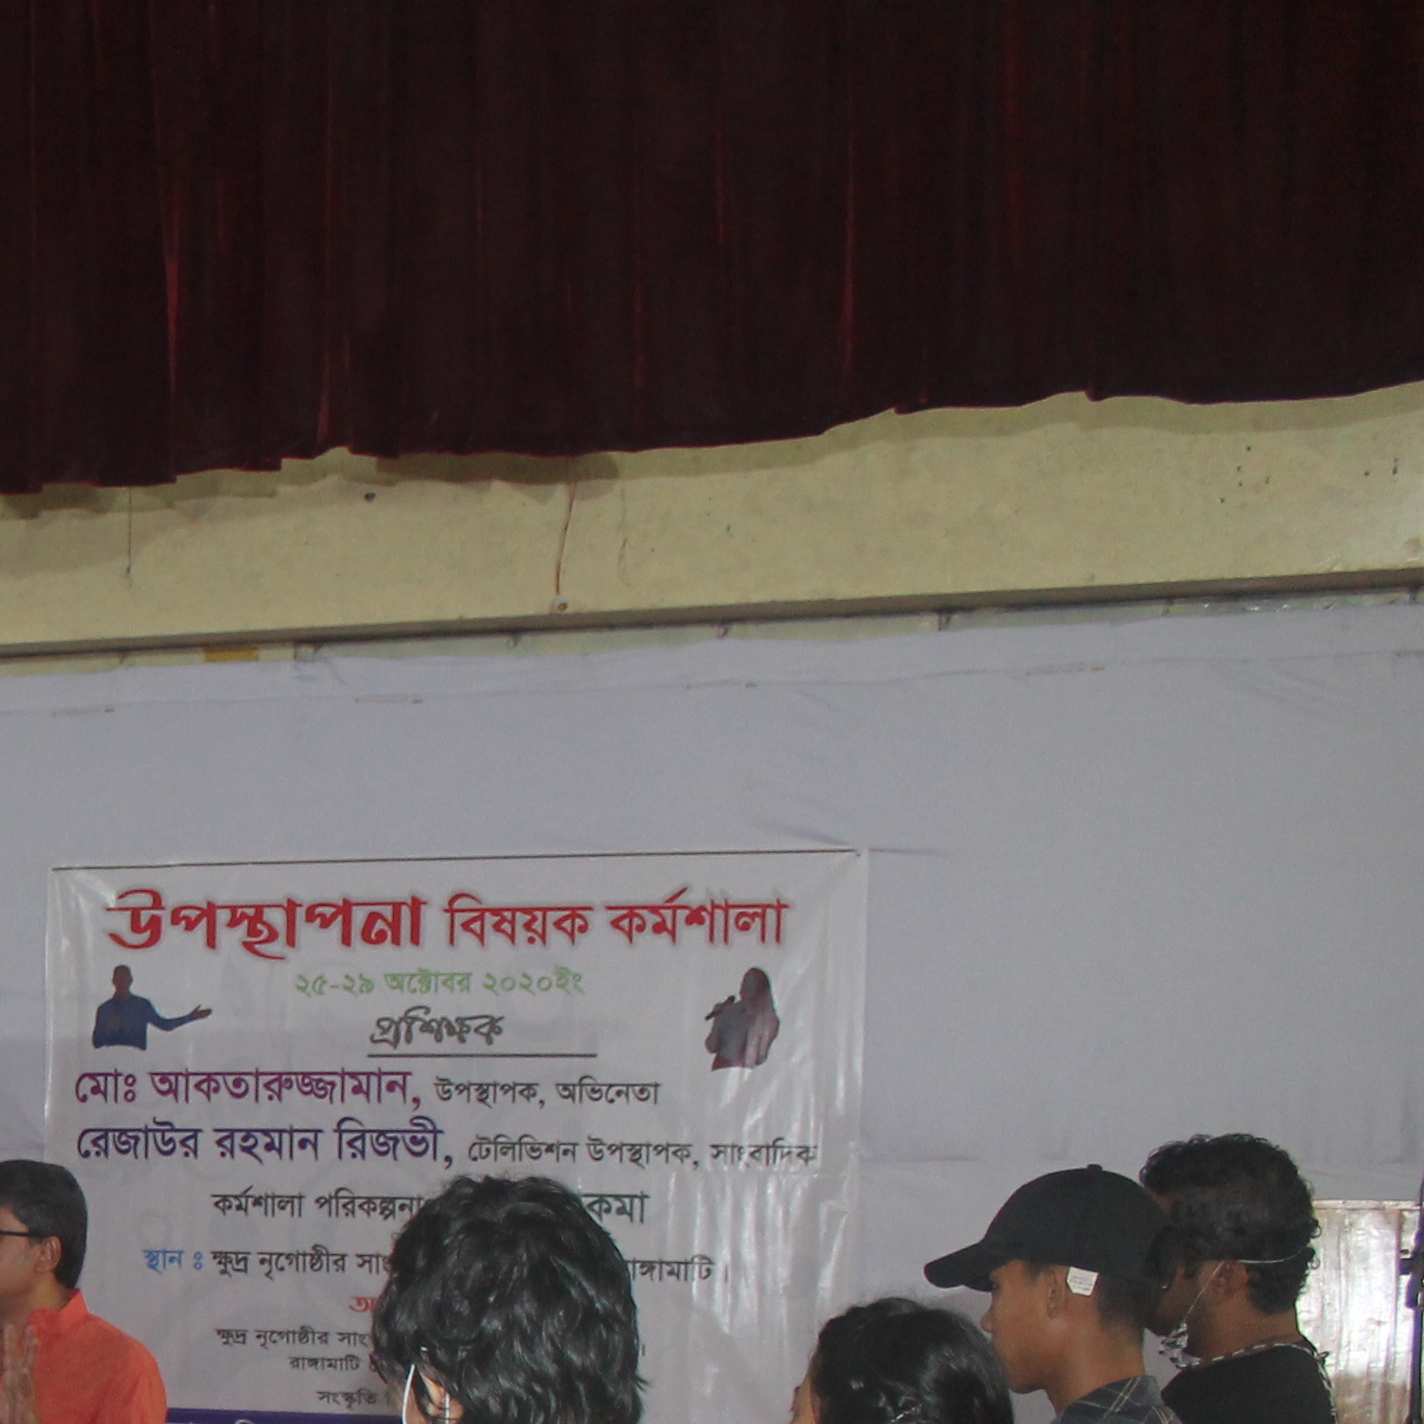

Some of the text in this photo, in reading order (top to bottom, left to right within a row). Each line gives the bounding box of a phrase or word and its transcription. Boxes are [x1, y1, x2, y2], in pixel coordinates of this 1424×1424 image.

[105, 886, 790, 960] উপস্থাপনা বিষয়ক কর্মশালা
[295, 971, 375, 997] ২৫-২৯
[384, 967, 473, 996] অক্টোবর
[368, 1004, 505, 1049] প্রশিক্ষক
[74, 1067, 662, 1112] মোঃ আকতারুজ্জামান, উপস্থাপক, অভিনেতা
[76, 1116, 203, 1161] রেজাউর
[212, 1124, 324, 1165] রহমান
[332, 1115, 453, 1170] রিজভী,
[467, 1133, 580, 1165] টেলিভিশন
[585, 1135, 702, 1171] উপস্থাপক,
[210, 1185, 306, 1219] কর্মশালা
[142, 1247, 185, 1275] স্থান
[210, 1249, 252, 1281] ক্ষুদ্র
[256, 1242, 349, 1281] নৃগোষ্ঠীর
[214, 1327, 250, 1346] ক্ষুদ্র
[254, 1324, 331, 1350] নৃগোষ্ঠীর
[287, 1354, 362, 1372] রাঙ্গামাটি
